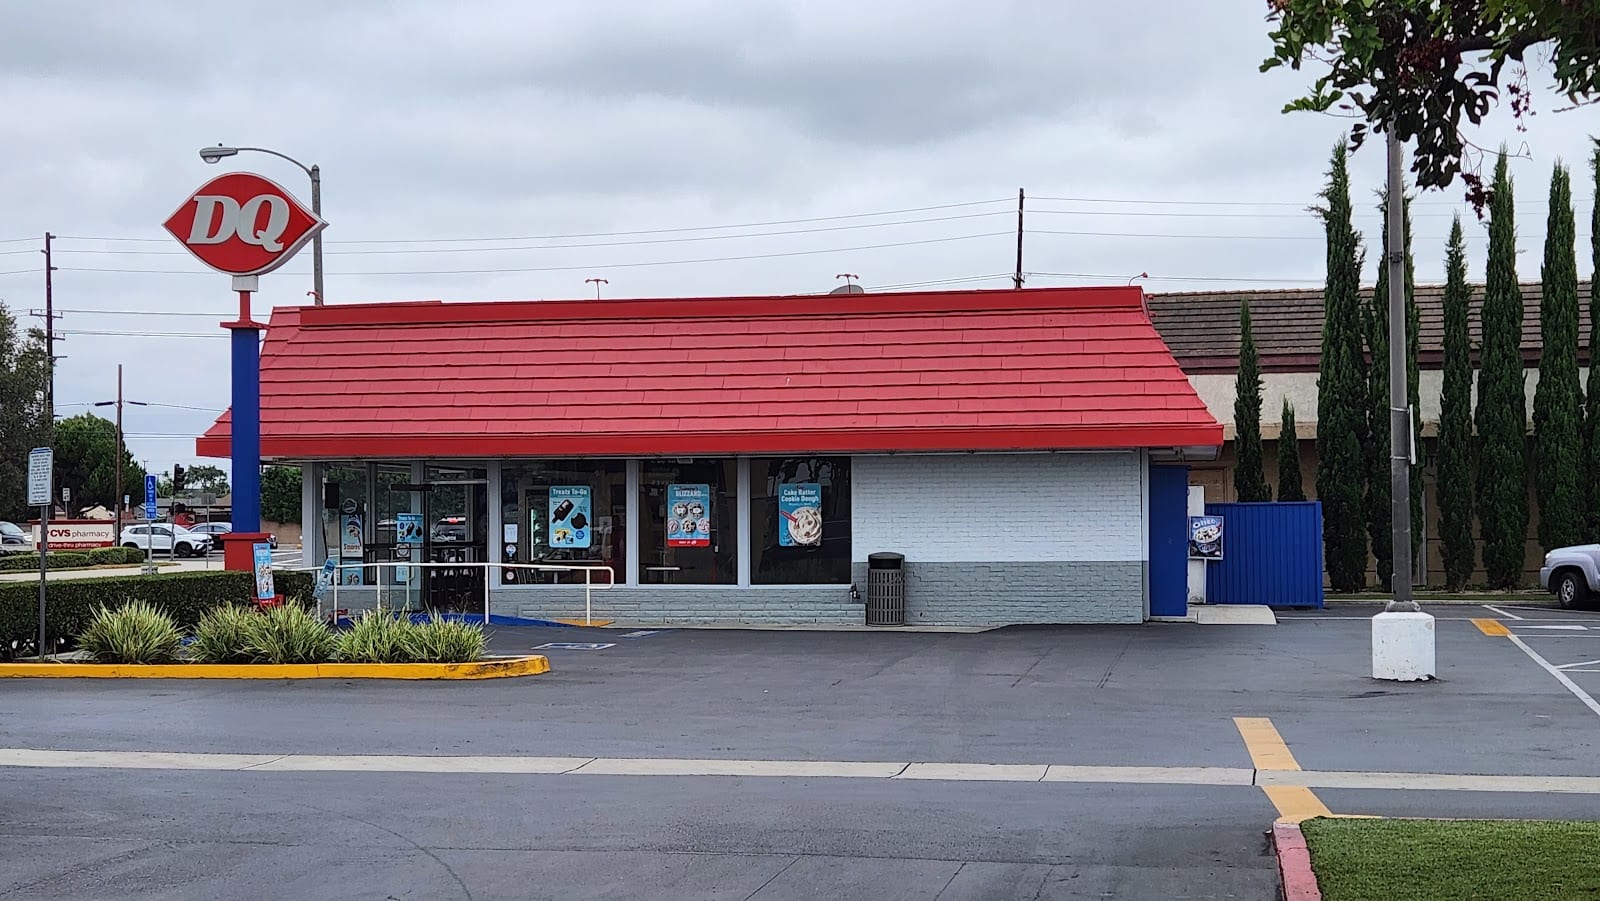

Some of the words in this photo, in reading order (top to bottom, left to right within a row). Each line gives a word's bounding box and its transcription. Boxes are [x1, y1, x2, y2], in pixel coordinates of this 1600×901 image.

[186, 194, 290, 253] DQ
[50, 529, 71, 537] CVS
[72, 530, 110, 538] pharmacy
